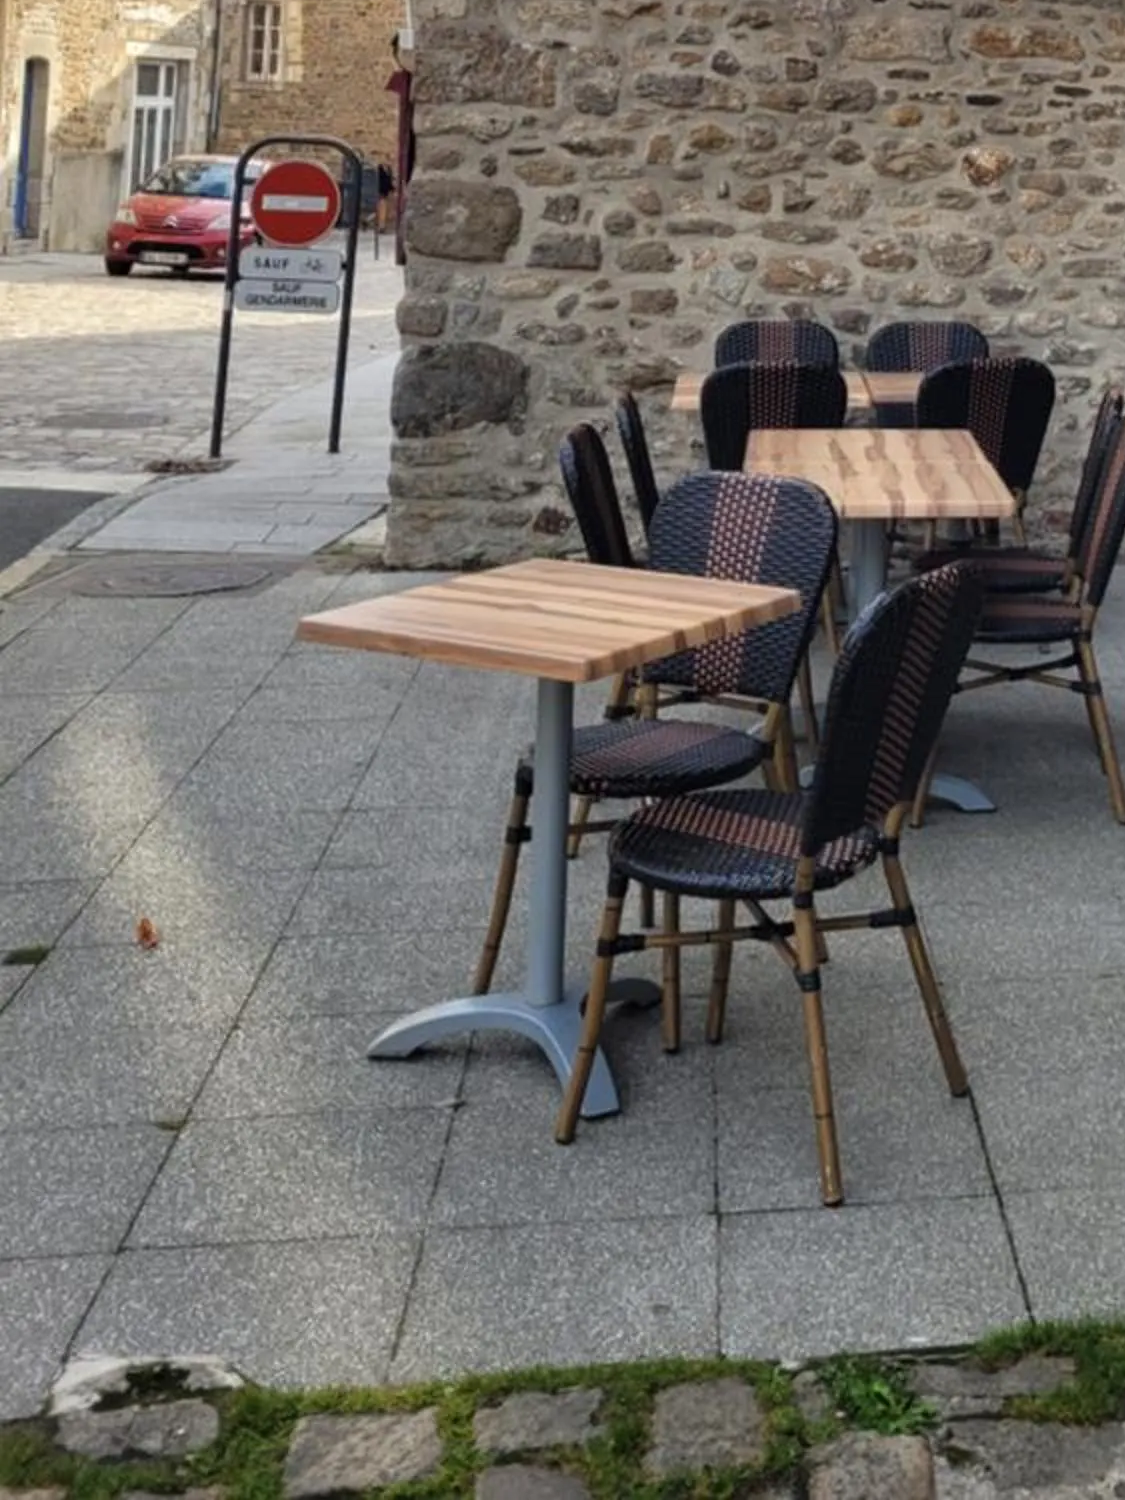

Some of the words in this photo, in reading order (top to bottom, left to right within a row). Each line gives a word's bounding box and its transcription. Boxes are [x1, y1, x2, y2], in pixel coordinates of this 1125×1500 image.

[254, 256, 290, 270] SAUF
[272, 282, 302, 294] SAUF
[244, 293, 328, 309] GENDARMERIE
